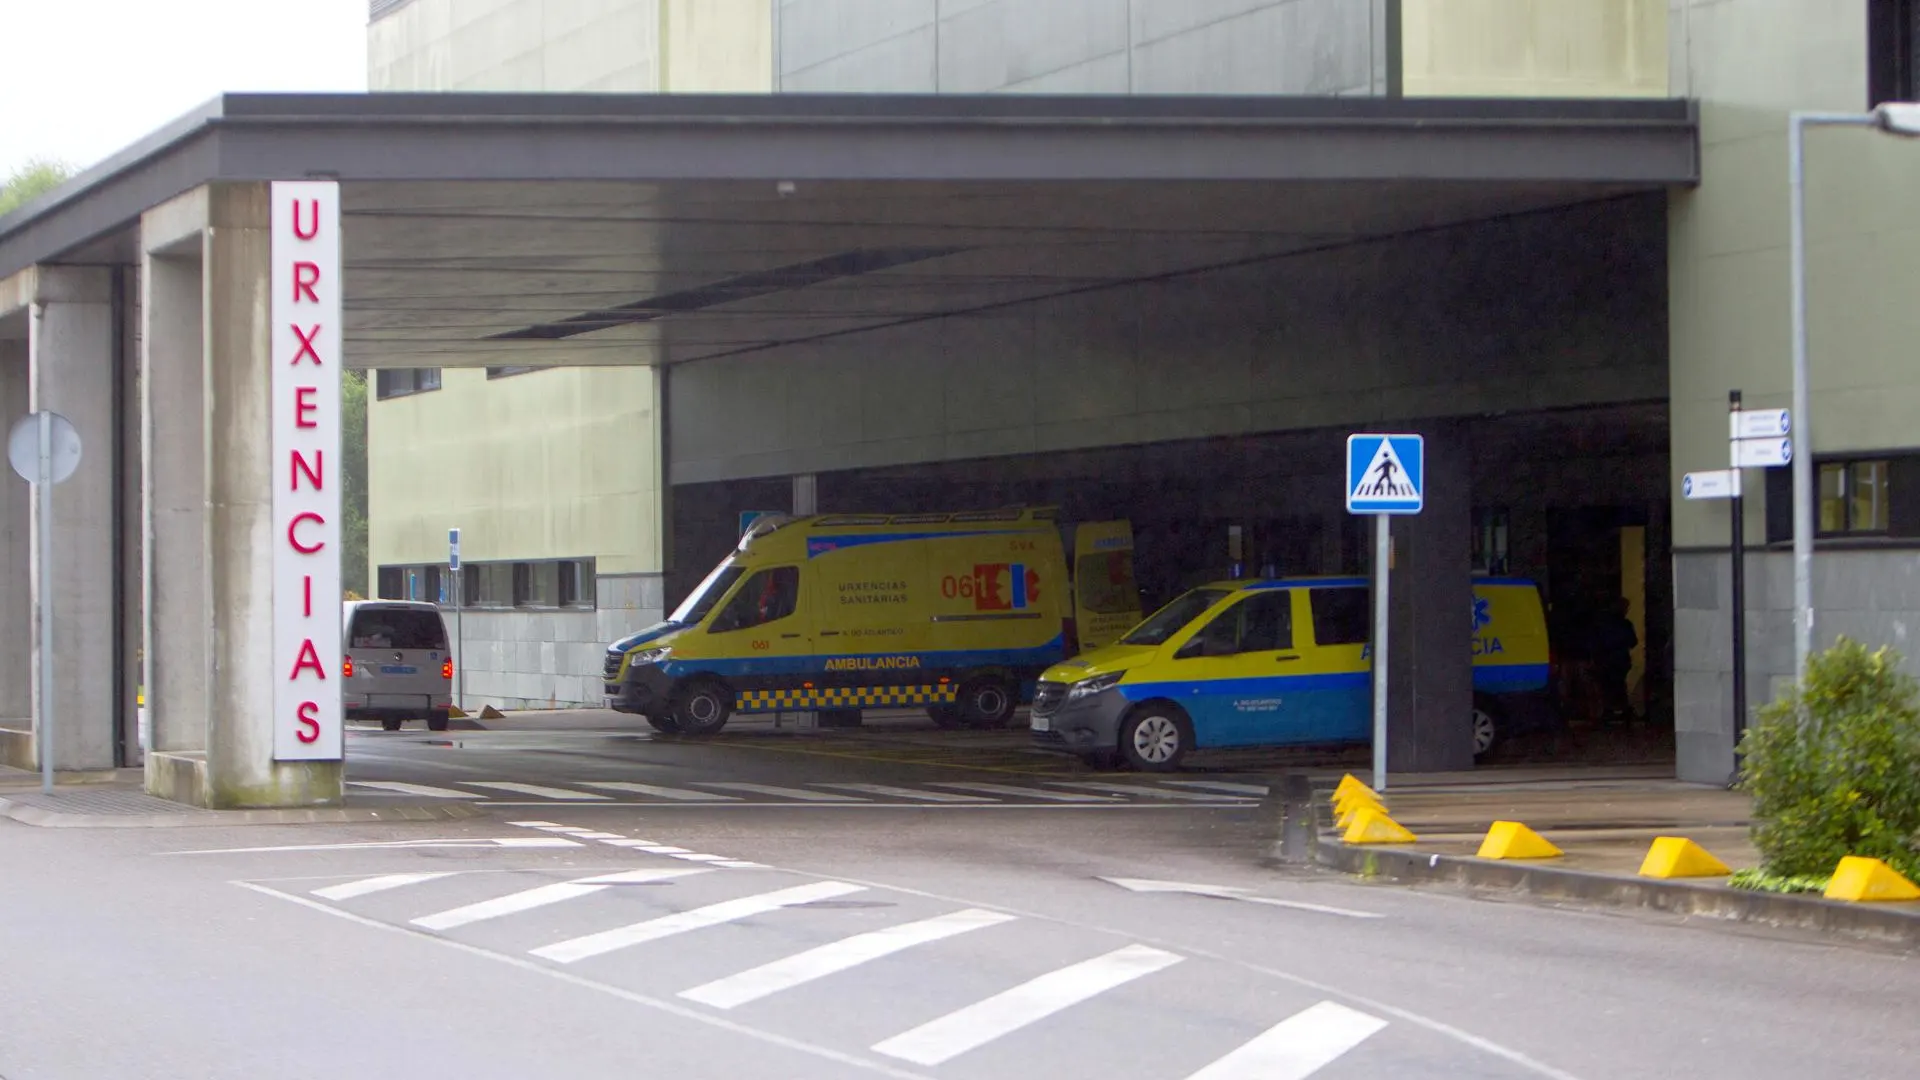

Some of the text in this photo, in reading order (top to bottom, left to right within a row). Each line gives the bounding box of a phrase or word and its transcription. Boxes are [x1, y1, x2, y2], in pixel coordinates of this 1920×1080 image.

[289, 199, 325, 744] URXENCIAS
[838, 580, 907, 591] URXENCIAS
[941, 574, 988, 599] 061
[840, 594, 908, 604] SANITARIAS
[752, 640, 770, 650] 061
[824, 655, 920, 670] AMBULANCIA
